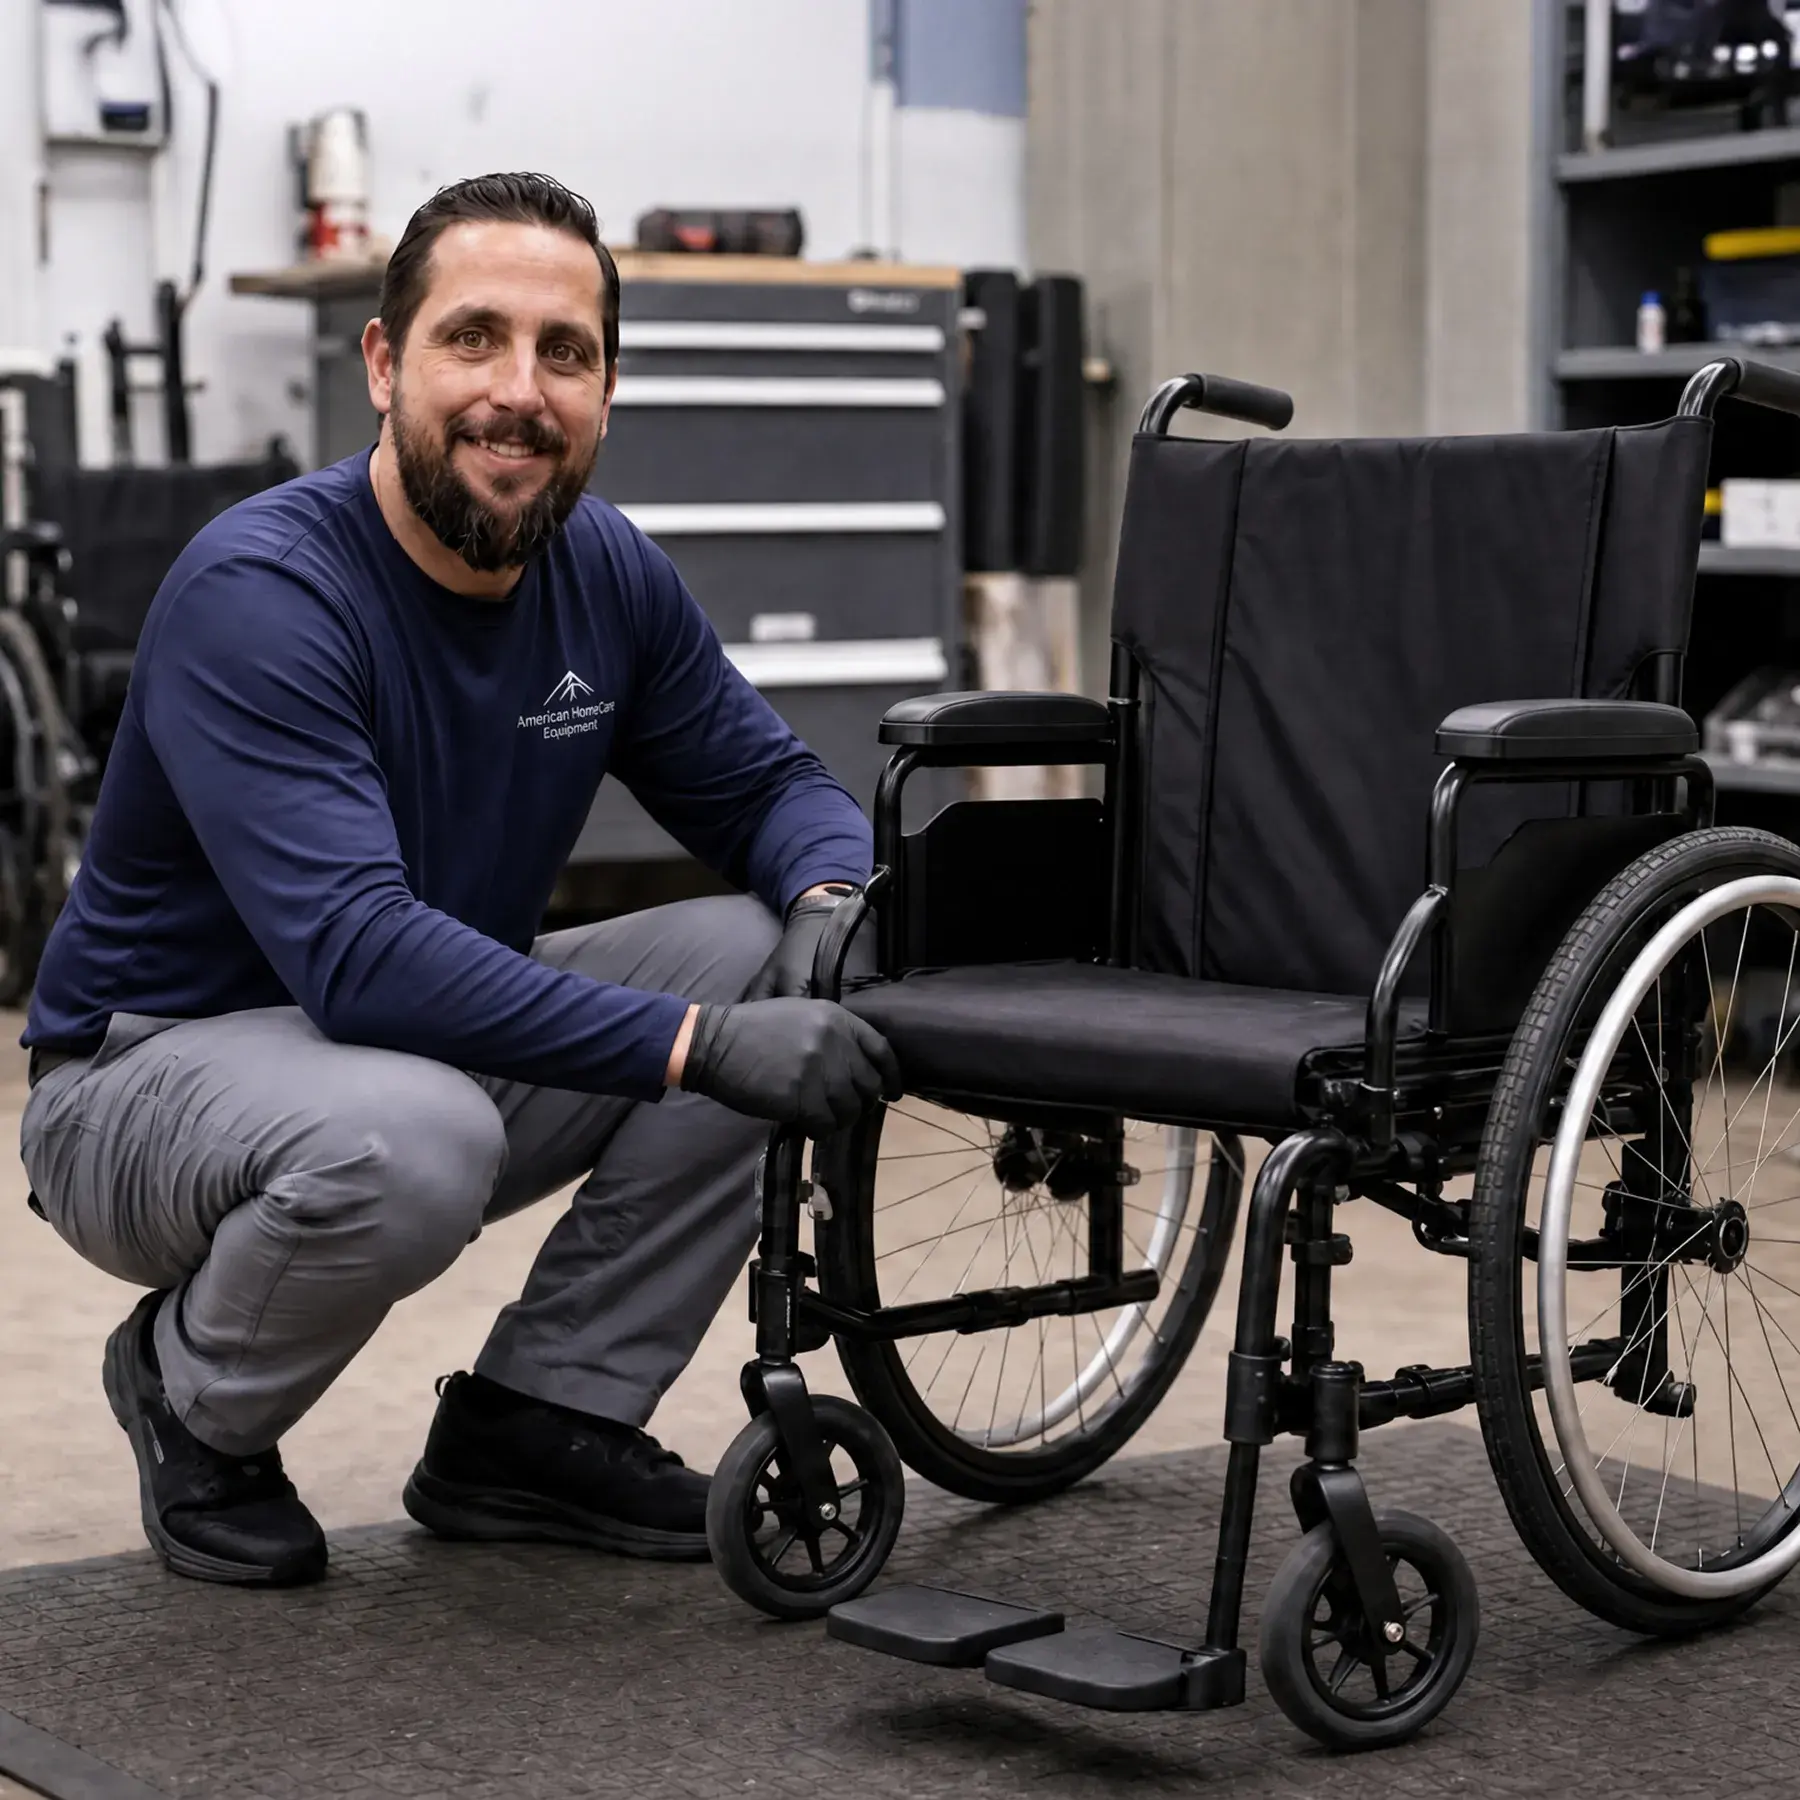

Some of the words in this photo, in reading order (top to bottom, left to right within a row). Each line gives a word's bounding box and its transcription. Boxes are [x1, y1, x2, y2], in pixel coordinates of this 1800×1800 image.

[517, 710, 570, 728] American
[571, 701, 615, 719] HomeCare
[543, 719, 598, 740] Equipment
